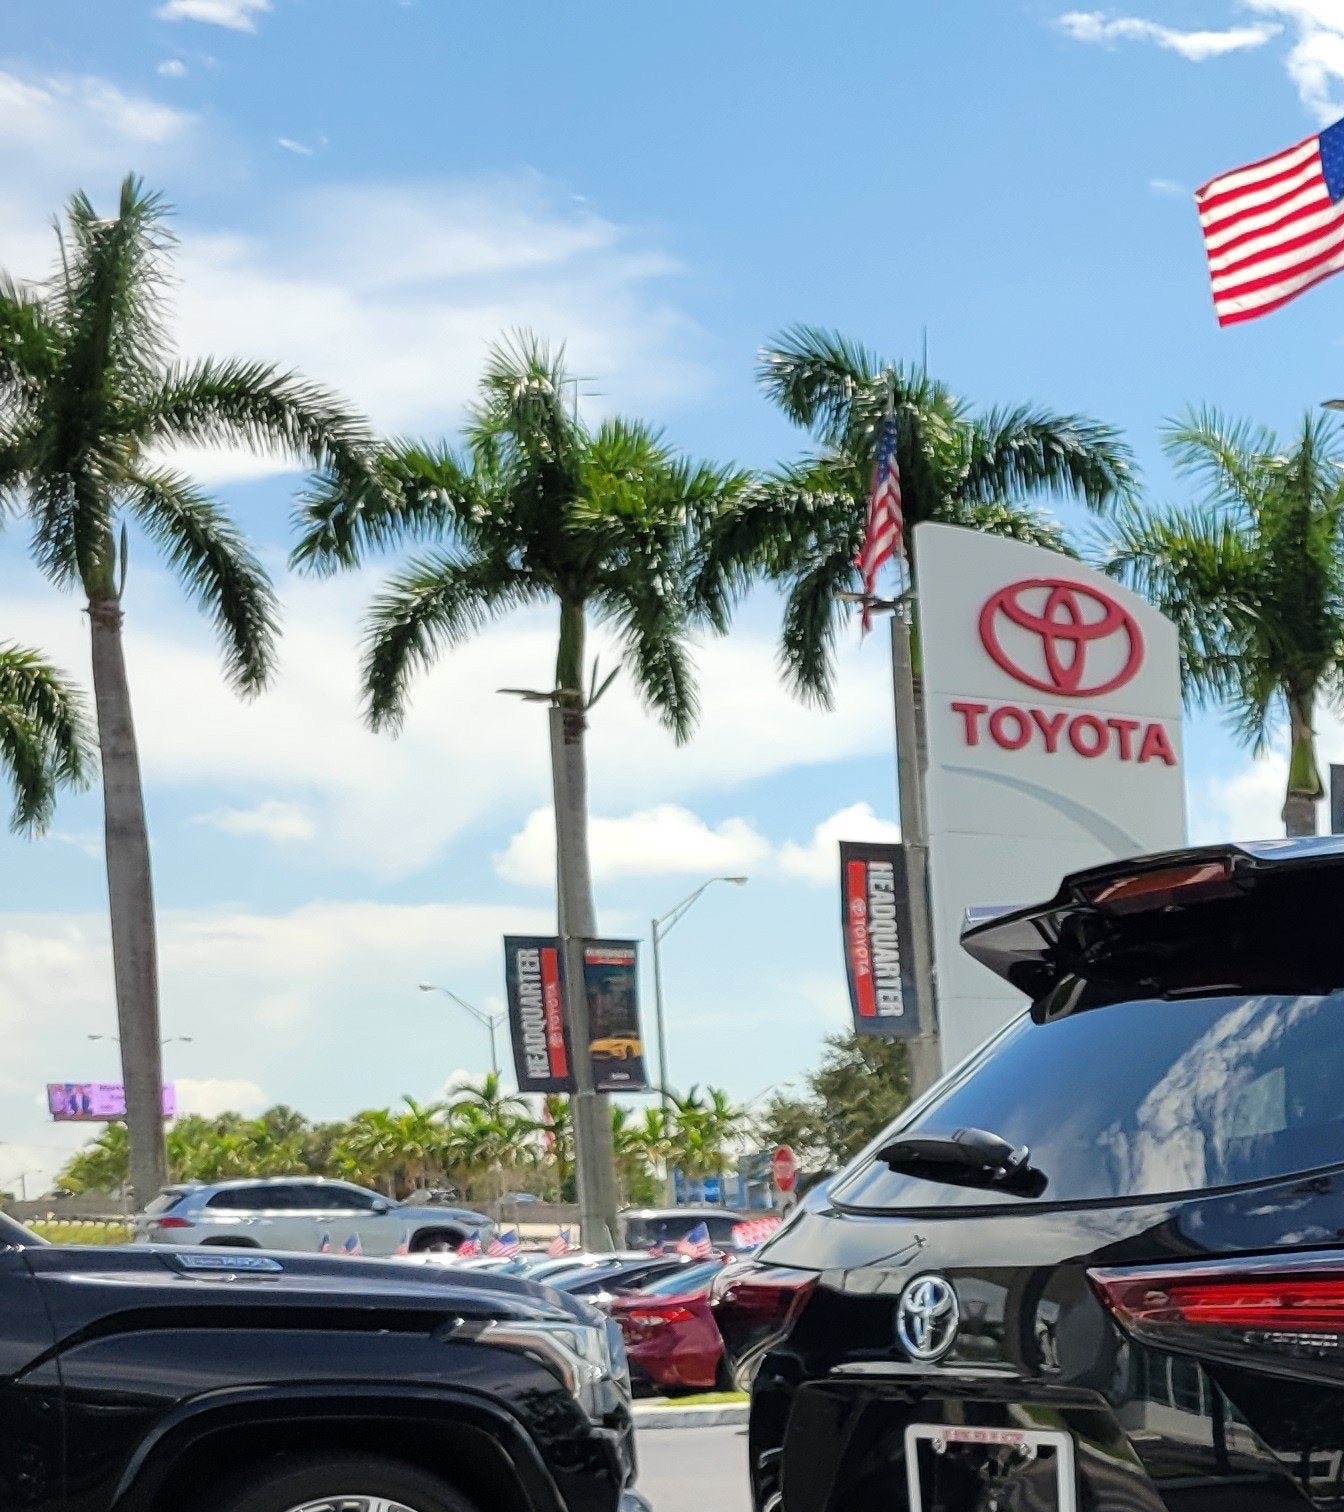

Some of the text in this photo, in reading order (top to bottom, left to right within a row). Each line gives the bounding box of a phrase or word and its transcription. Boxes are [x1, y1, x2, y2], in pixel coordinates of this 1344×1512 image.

[952, 702, 1177, 766] TOYOTA
[867, 861, 904, 1017] HEADQUARTER
[517, 949, 550, 1079] HEADQUARTER
